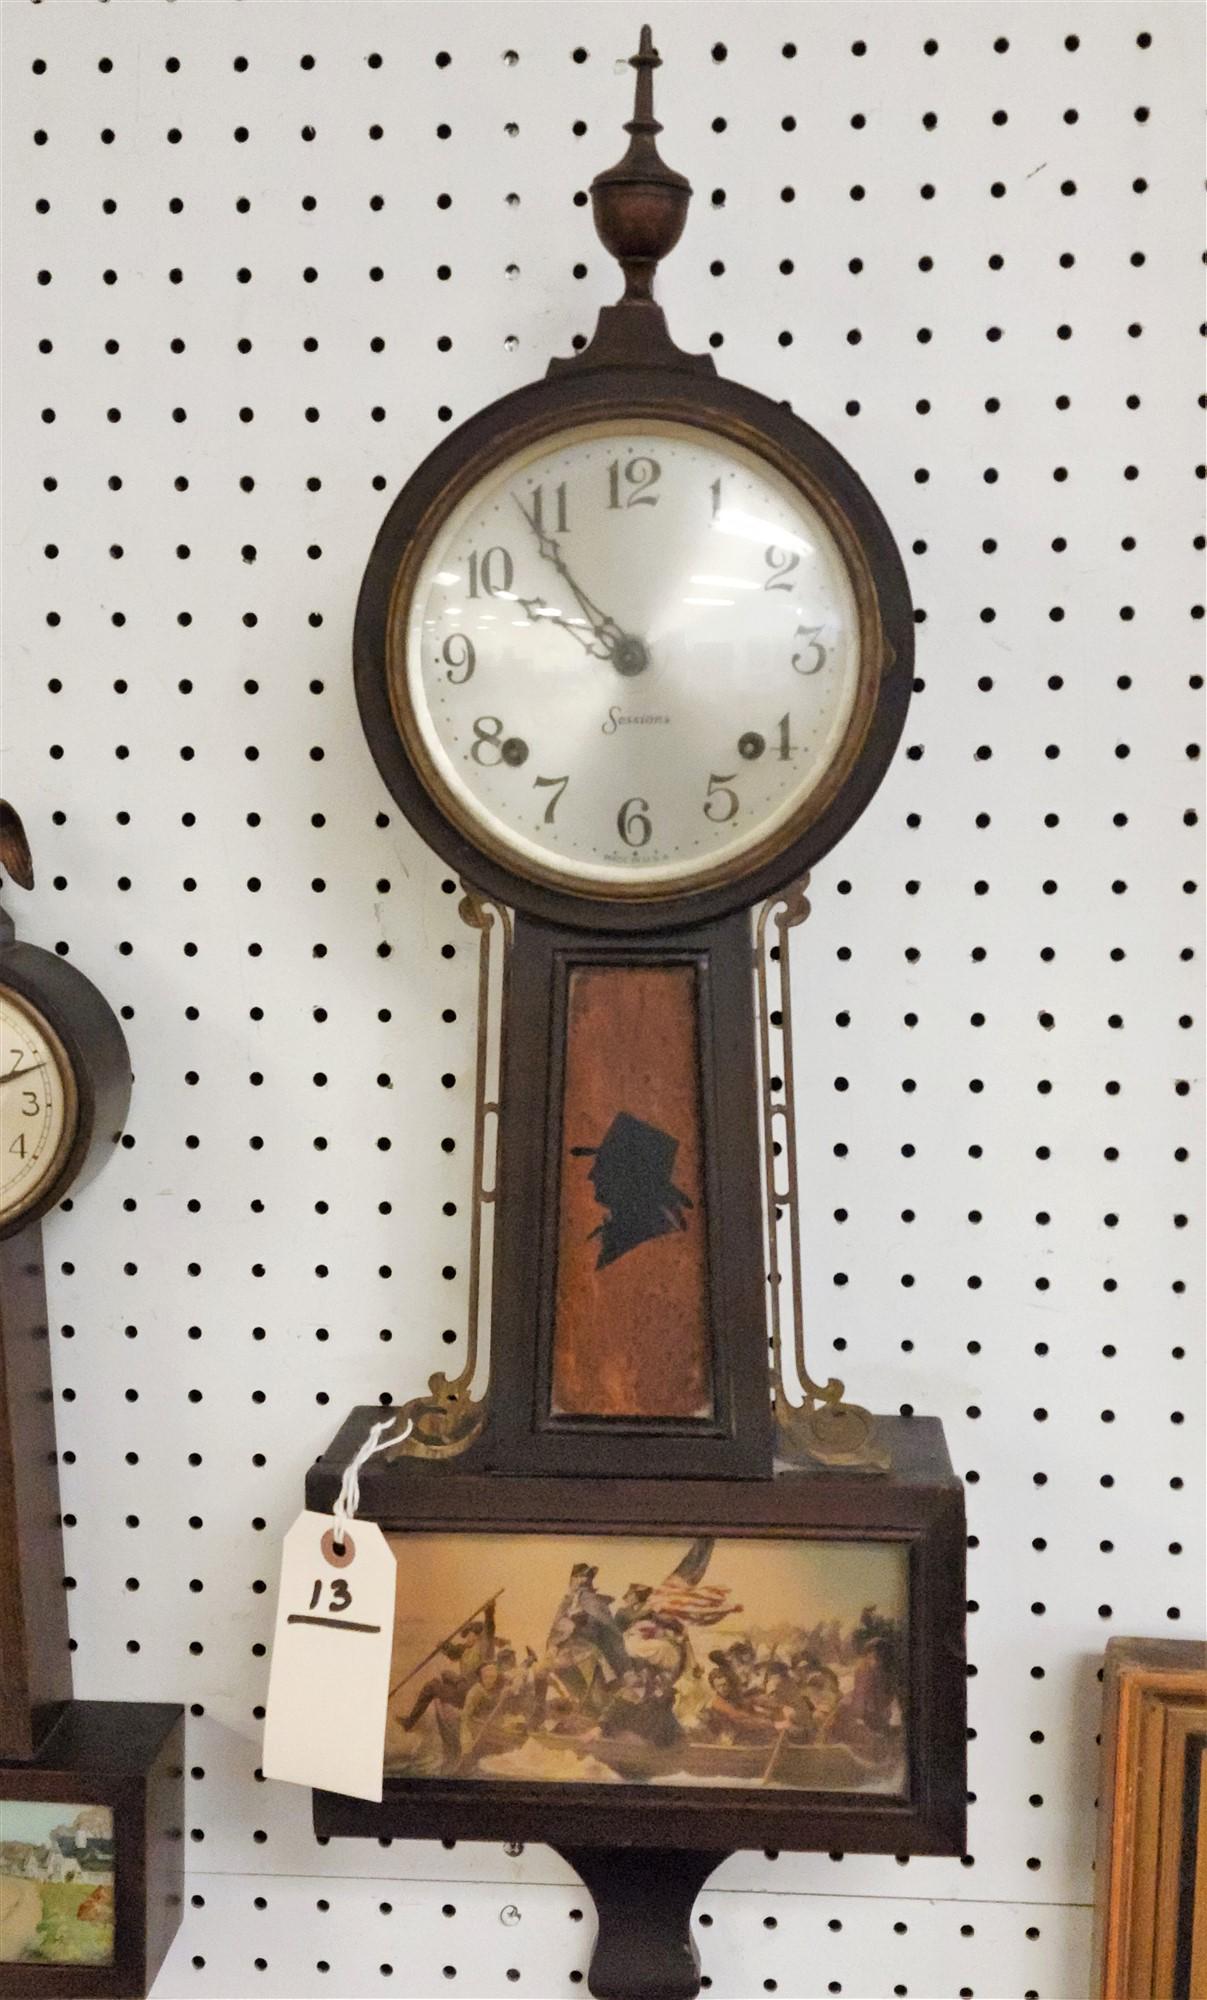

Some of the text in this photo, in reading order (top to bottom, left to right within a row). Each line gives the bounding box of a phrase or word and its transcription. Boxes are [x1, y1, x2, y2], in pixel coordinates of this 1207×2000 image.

[532, 481, 570, 533] 11
[607, 458, 661, 508] 12
[709, 478, 721, 527] 1
[468, 546, 514, 599] 10
[765, 545, 799, 592] 2
[443, 633, 475, 684] 9
[792, 626, 827, 675] 3
[471, 716, 505, 767] 8
[602, 707, 671, 734] Sessions
[769, 712, 798, 761] 4
[533, 775, 570, 824] 7
[617, 797, 652, 848] 6
[703, 774, 740, 823] 5
[22, 1092, 40, 1116] 3
[9, 1133, 27, 1159] 4
[309, 1579, 352, 1612] 13
